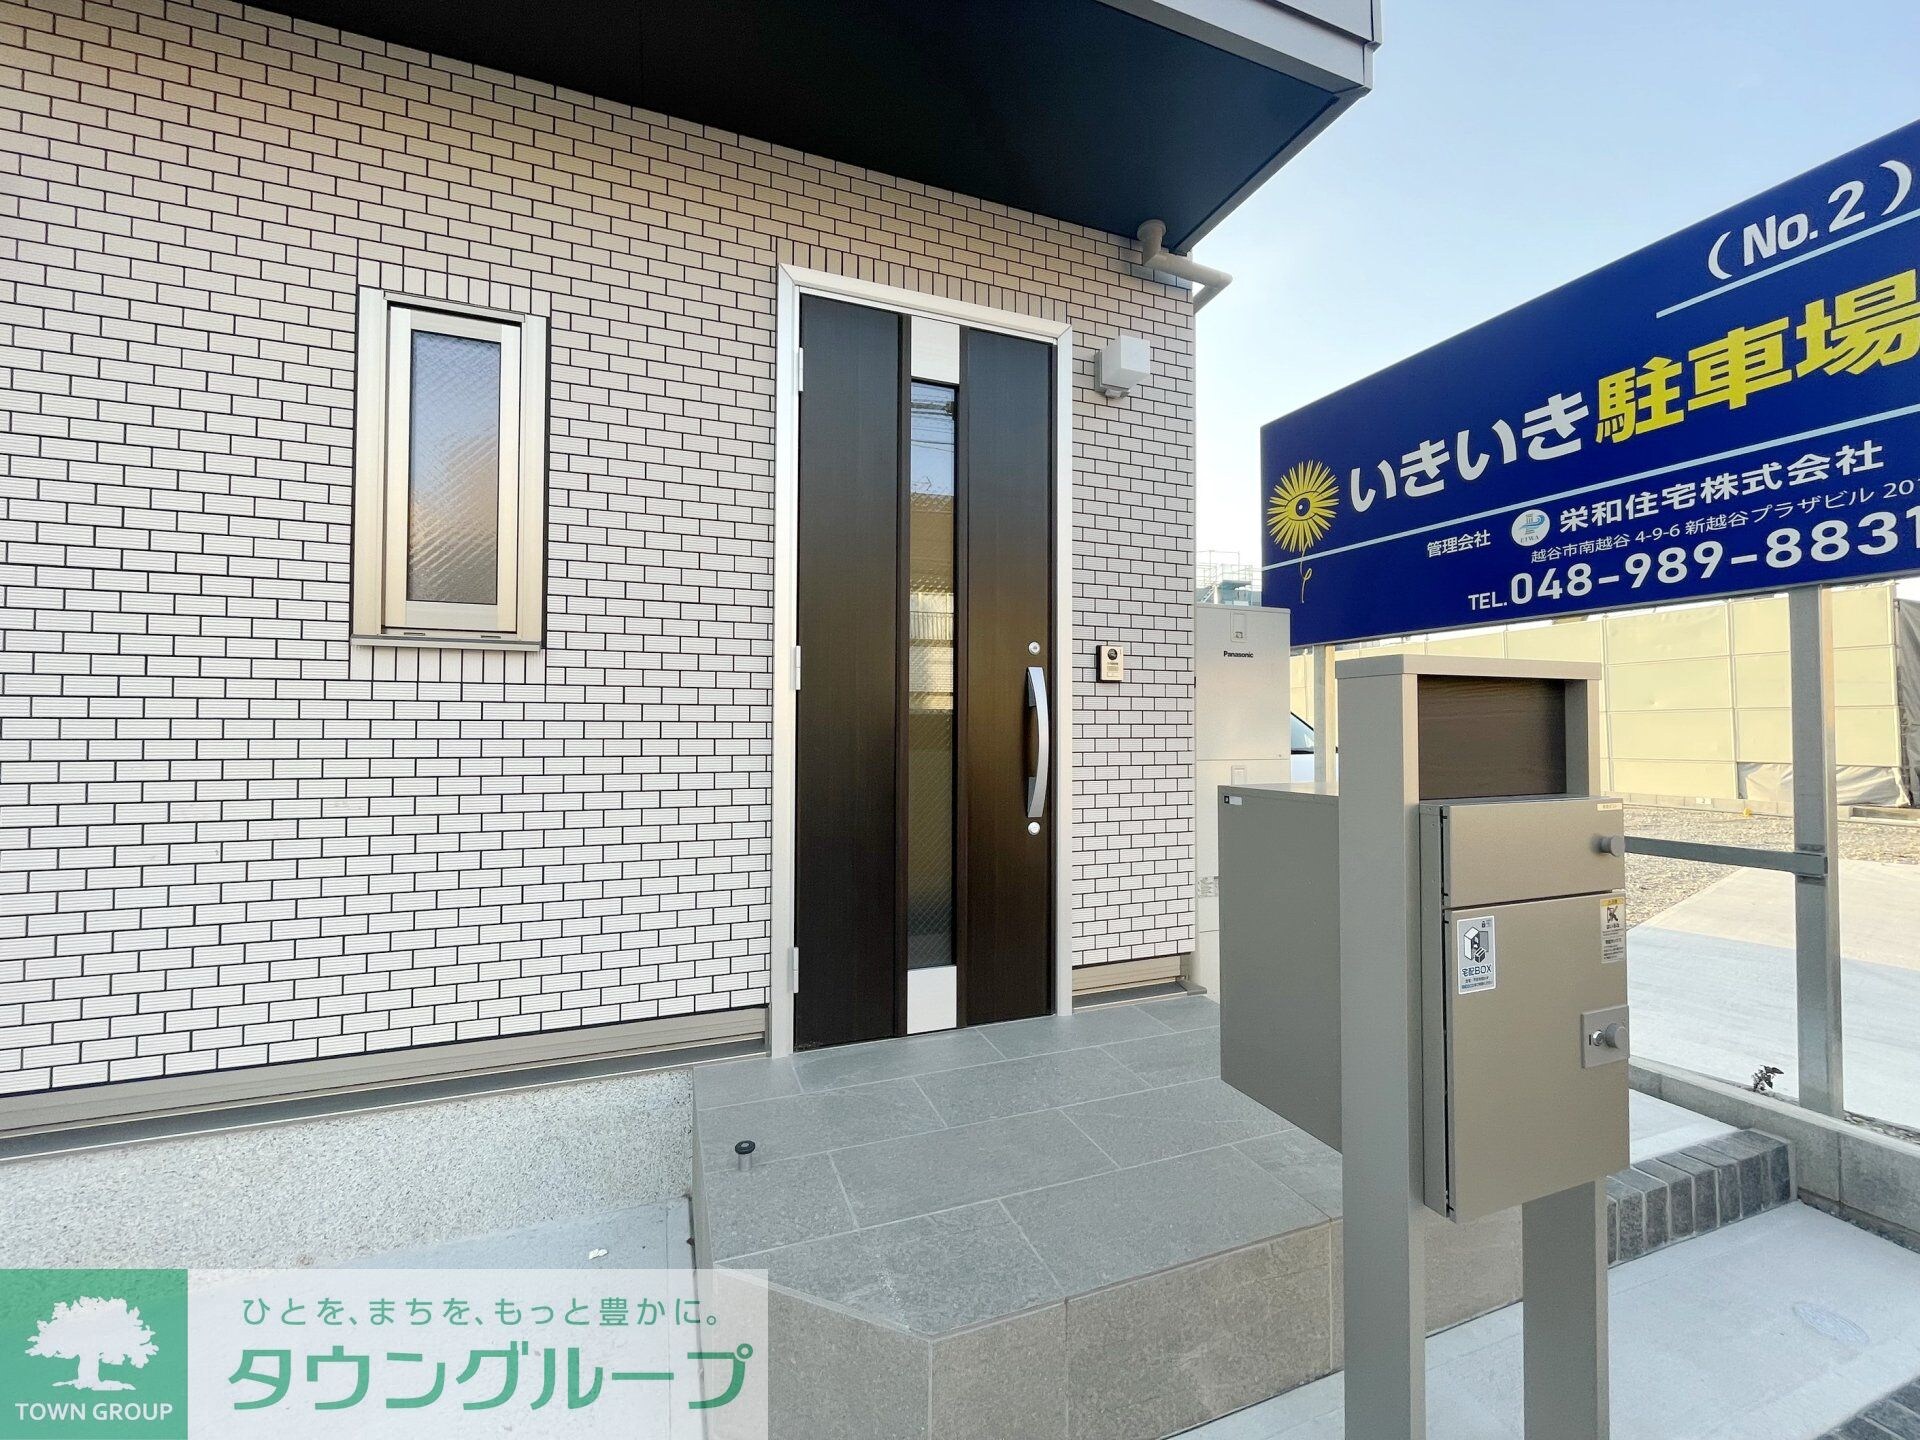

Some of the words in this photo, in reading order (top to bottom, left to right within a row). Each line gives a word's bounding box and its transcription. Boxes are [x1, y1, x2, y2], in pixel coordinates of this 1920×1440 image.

[1350, 268, 1920, 513] いきいき駐車場
[1530, 533, 1631, 564] 越谷市南越谷
[1634, 523, 1681, 543] 4-9-6
[1684, 487, 1875, 536] 新越谷プラザビル
[1882, 478, 1920, 499] 20
[1559, 439, 1885, 533] 栄和住宅株式会社
[1426, 529, 1492, 558] 管理会社
[1467, 591, 1508, 611] TEL.
[1510, 505, 1920, 605] 048-989-8831
[1223, 650, 1254, 659] Panasonic
[1461, 963, 1492, 977] 宅配BOX
